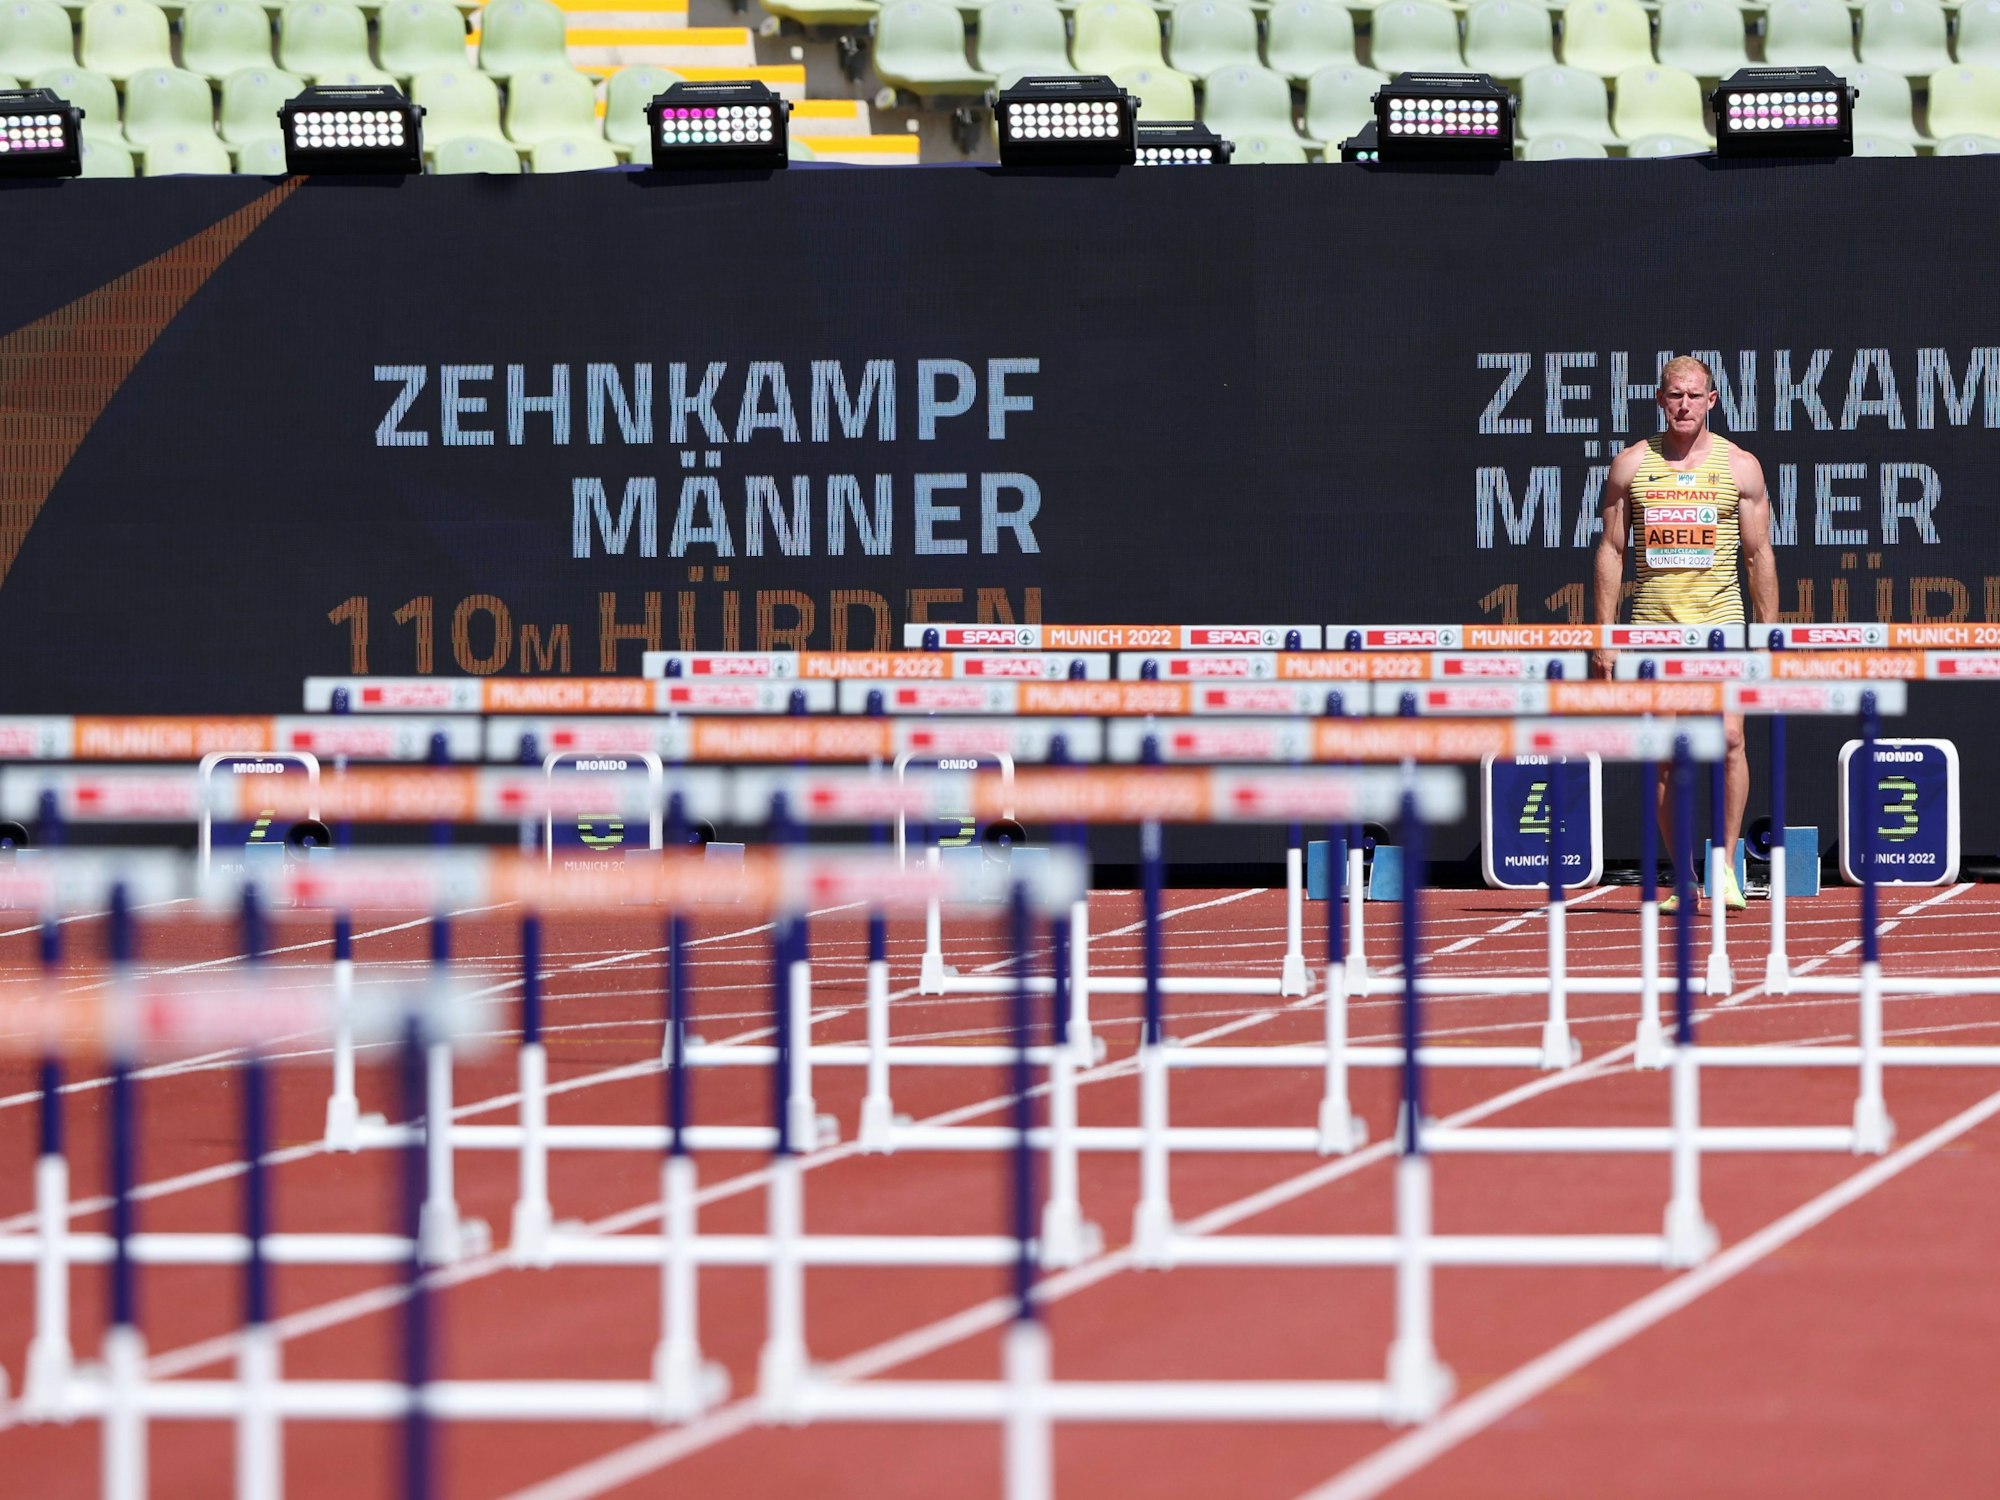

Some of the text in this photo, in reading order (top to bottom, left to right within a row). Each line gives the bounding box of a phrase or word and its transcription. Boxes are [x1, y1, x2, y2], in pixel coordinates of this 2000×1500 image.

[373, 357, 1041, 447] ZEHNKAMPF
[1646, 490, 1719, 501] GERMANY
[571, 449, 1042, 559] MÄNNER
[1647, 509, 1697, 521] SPAR
[1648, 529, 1714, 545] ABELE
[1649, 556, 1711, 566] MUNICH 2022
[962, 629, 1261, 645] SPAR MUNICH 2022 SPAR
[1383, 629, 1681, 646] SPAR MUNICH 2022 SPAR
[1807, 629, 1861, 643] SPAR
[1896, 627, 1969, 644] MUNICH
[806, 656, 889, 677] MUNICH
[893, 656, 944, 677] 2022
[1284, 656, 1367, 678] MUNICH
[1372, 656, 1423, 678] 2022
[1779, 657, 1862, 678] MUNICH
[1866, 657, 1917, 678] 2022
[1873, 751, 1924, 762] MONDO
[233, 763, 285, 773] MONDO
[576, 760, 628, 770] MONDO
[938, 759, 978, 769] ONDO
[1877, 775, 1919, 842] 3
[1505, 855, 1549, 867] MUNICH
[1908, 853, 1936, 865] 2022
[564, 861, 608, 872] MUNICH
